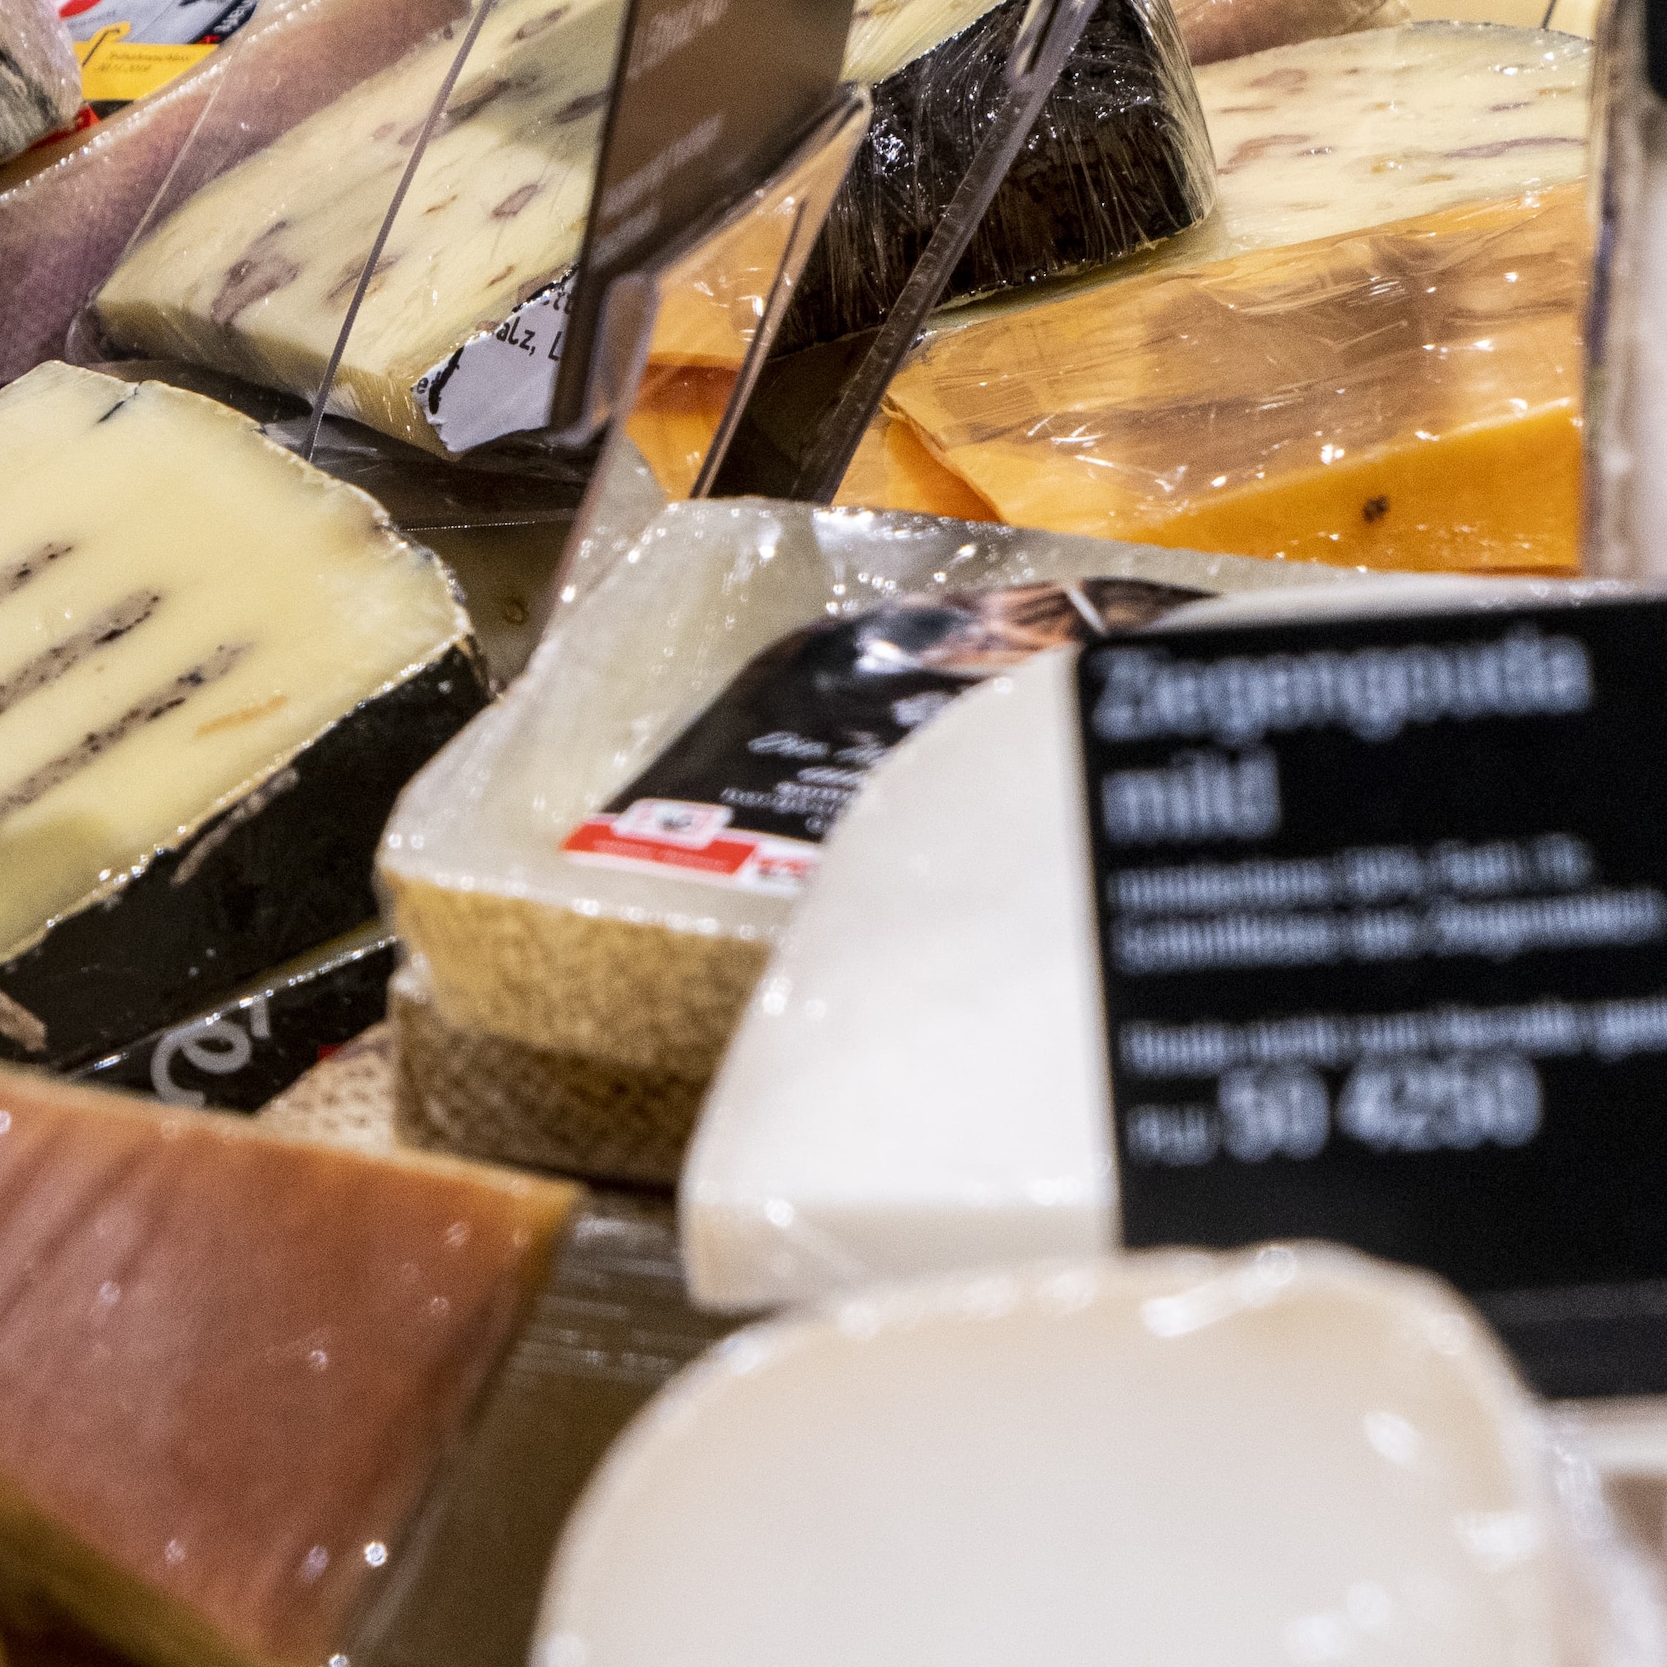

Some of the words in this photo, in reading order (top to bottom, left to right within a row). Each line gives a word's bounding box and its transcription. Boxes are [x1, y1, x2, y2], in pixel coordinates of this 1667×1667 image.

[496, 316, 536, 357] alz,
[1091, 632, 1595, 744] Ziegengouda
[1103, 744, 1283, 843] mild
[1217, 1064, 1331, 1162] 50
[1335, 1054, 1543, 1154] 4250
